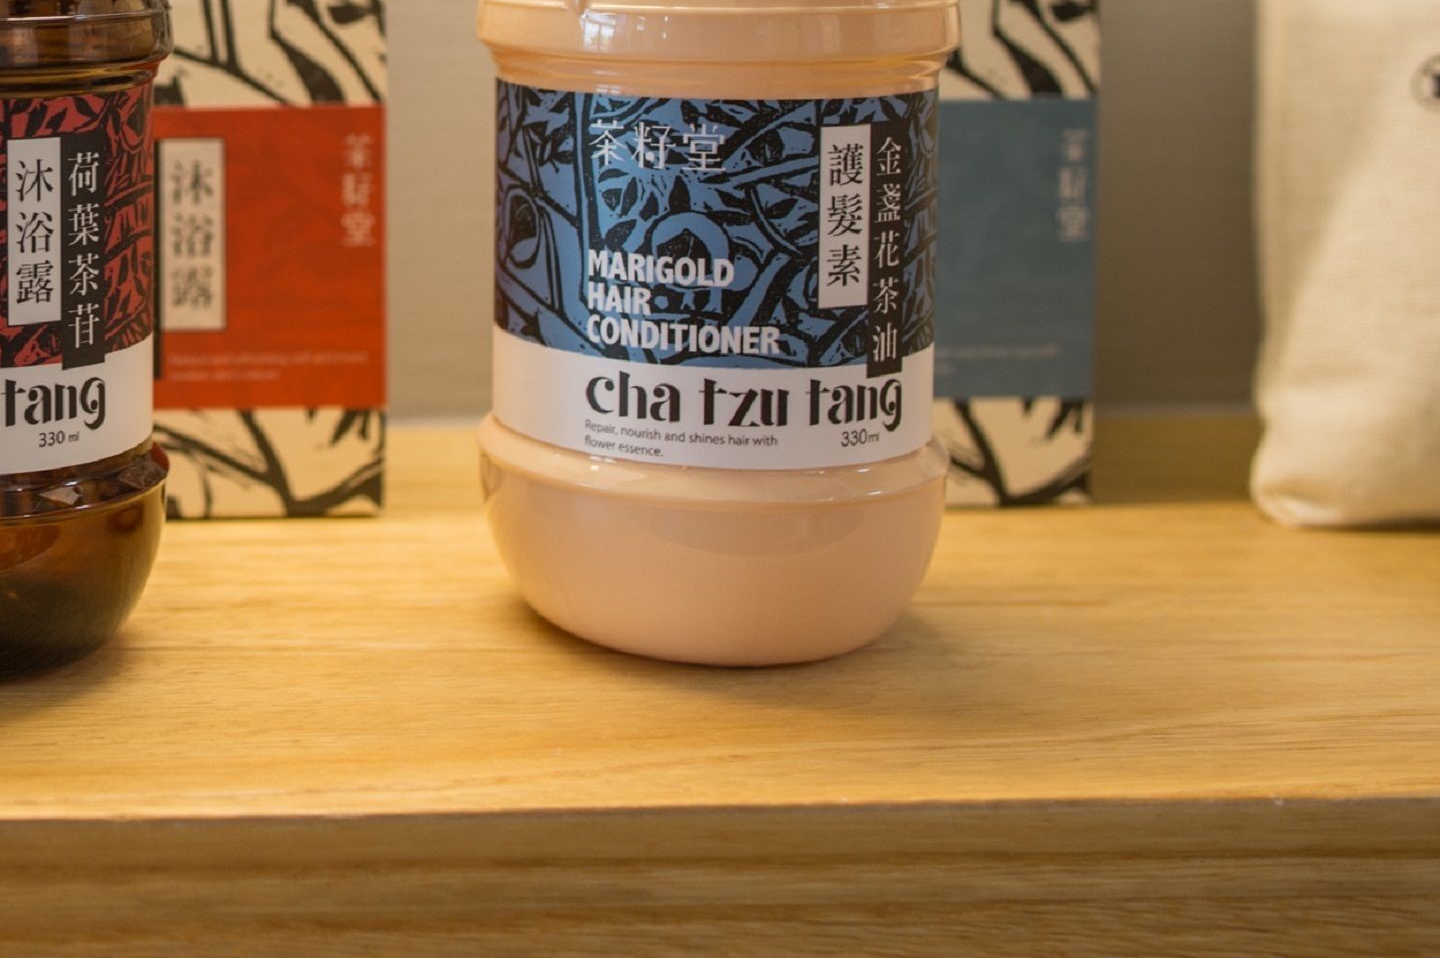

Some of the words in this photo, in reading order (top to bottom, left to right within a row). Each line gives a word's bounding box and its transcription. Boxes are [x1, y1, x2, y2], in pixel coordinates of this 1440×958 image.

[589, 119, 726, 171] 茶籽堂
[15, 159, 54, 304] 沐浴露
[826, 143, 864, 287] 護髮素
[67, 151, 100, 349] 荷葉茶苷
[588, 249, 734, 288] MARIGOLD
[872, 136, 902, 362] 金盞花茶油
[588, 281, 651, 315] HAIR
[587, 314, 781, 354] CONDITIONER
[0, 376, 106, 430] tang
[585, 370, 680, 423] cha
[699, 378, 789, 427] tzu
[805, 378, 902, 432] tang
[38, 431, 65, 448] 330
[68, 431, 79, 442] ml
[585, 419, 618, 435] Repair,
[620, 427, 661, 440] nourish
[664, 432, 685, 442] and
[689, 433, 725, 445] shines
[728, 434, 750, 446] hair
[753, 435, 778, 446] with
[585, 434, 616, 450] flower
[618, 443, 664, 457] essence.
